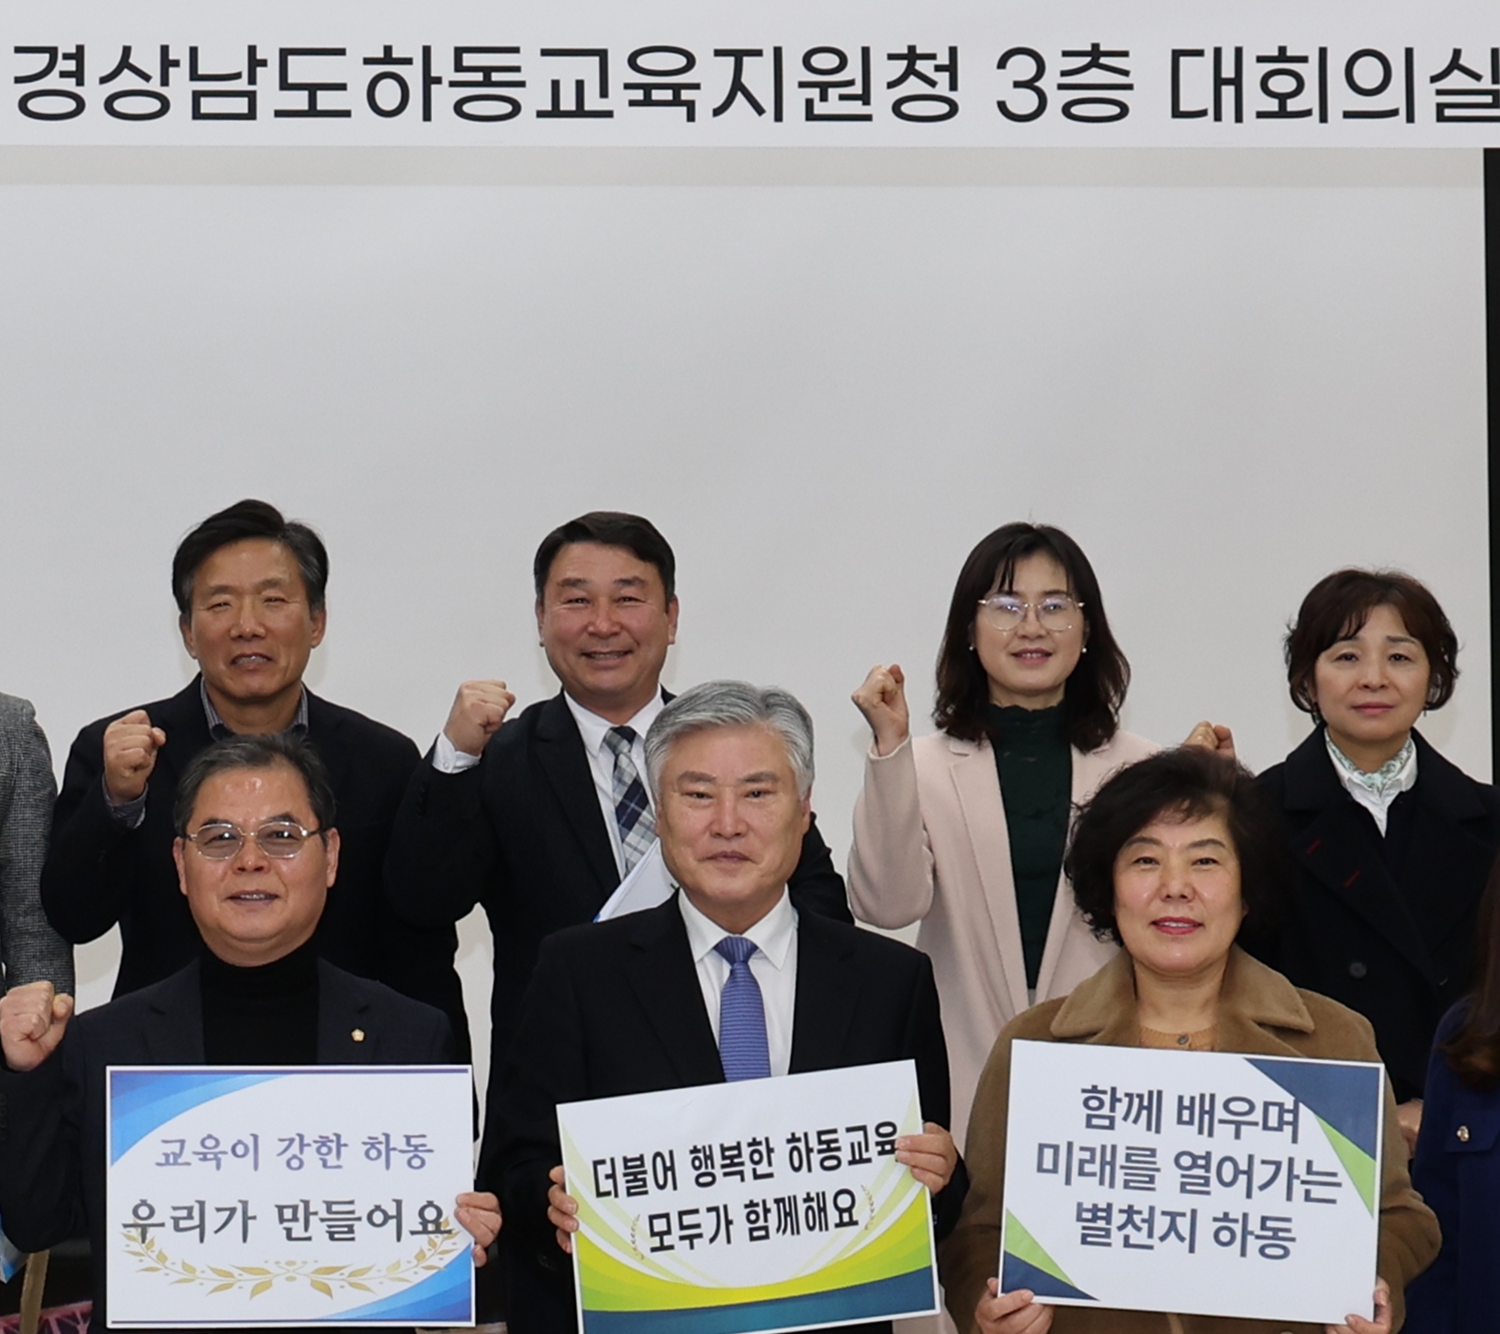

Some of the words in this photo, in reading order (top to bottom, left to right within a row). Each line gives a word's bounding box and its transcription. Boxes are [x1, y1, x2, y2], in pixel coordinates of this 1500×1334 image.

[14, 44, 959, 124] 경상남도하동교육지원청
[997, 42, 1134, 124] 3층
[1080, 1084, 1164, 1135] 함께
[1176, 1092, 1300, 1145] 배우며
[154, 1133, 260, 1172] 교육이
[276, 1132, 349, 1171] 강한
[361, 1132, 435, 1171] 하동
[592, 1148, 678, 1199] 더불어
[689, 1135, 776, 1190] 행복한
[785, 1120, 898, 1175] 하동교육
[1036, 1140, 1161, 1193] 미래를
[1173, 1149, 1343, 1205] 열어가는
[121, 1198, 257, 1245] 우리가
[274, 1197, 454, 1244] 만들어요
[647, 1203, 735, 1254] 모두가
[743, 1187, 860, 1243] 함께해요
[1075, 1200, 1199, 1255] 별천지
[1211, 1211, 1297, 1261] 하동
